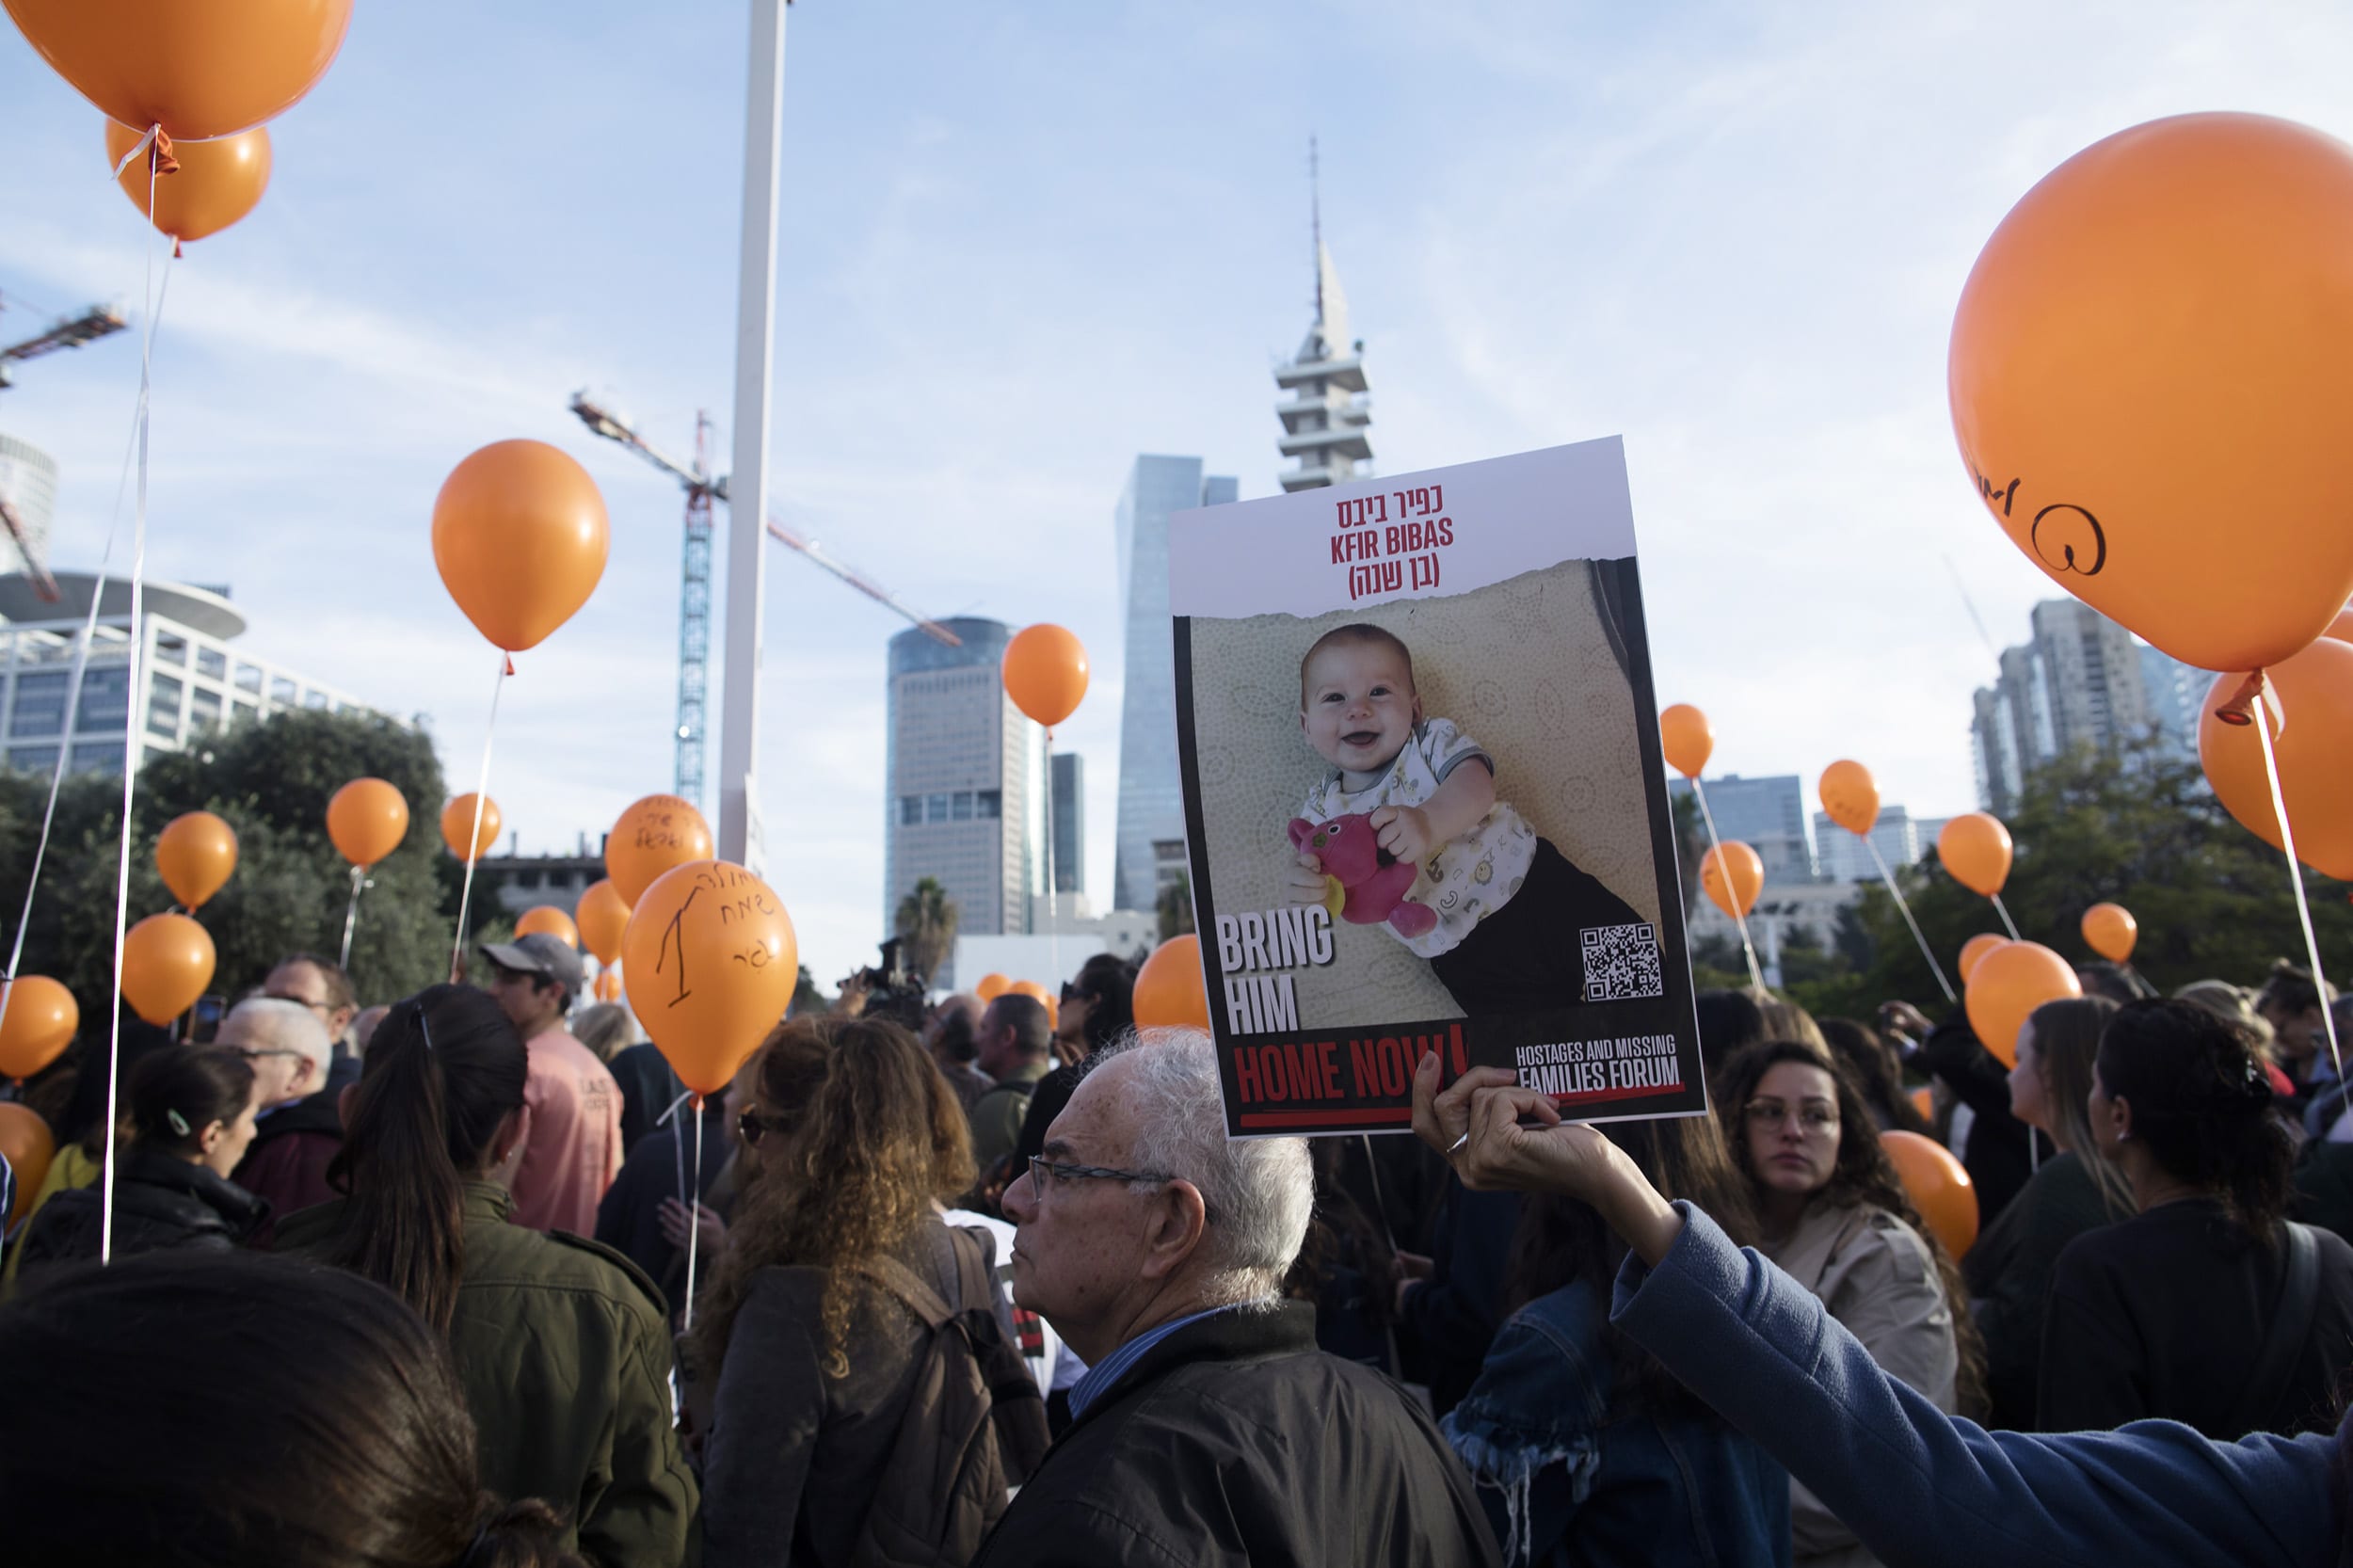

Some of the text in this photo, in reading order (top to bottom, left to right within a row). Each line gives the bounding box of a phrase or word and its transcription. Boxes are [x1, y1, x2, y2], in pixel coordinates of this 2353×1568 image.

[1337, 485, 1443, 528] כפיר ביבס
[1330, 517, 1454, 565] KFIR BIBAS
[1215, 904, 1334, 972] BRING
[1225, 974, 1299, 1035] HIM
[1234, 1042, 1345, 1103] HOME
[1515, 1033, 1676, 1066] HOSTAGES AND MISSING
[1517, 1056, 1680, 1096] FAMILIES FORUM
